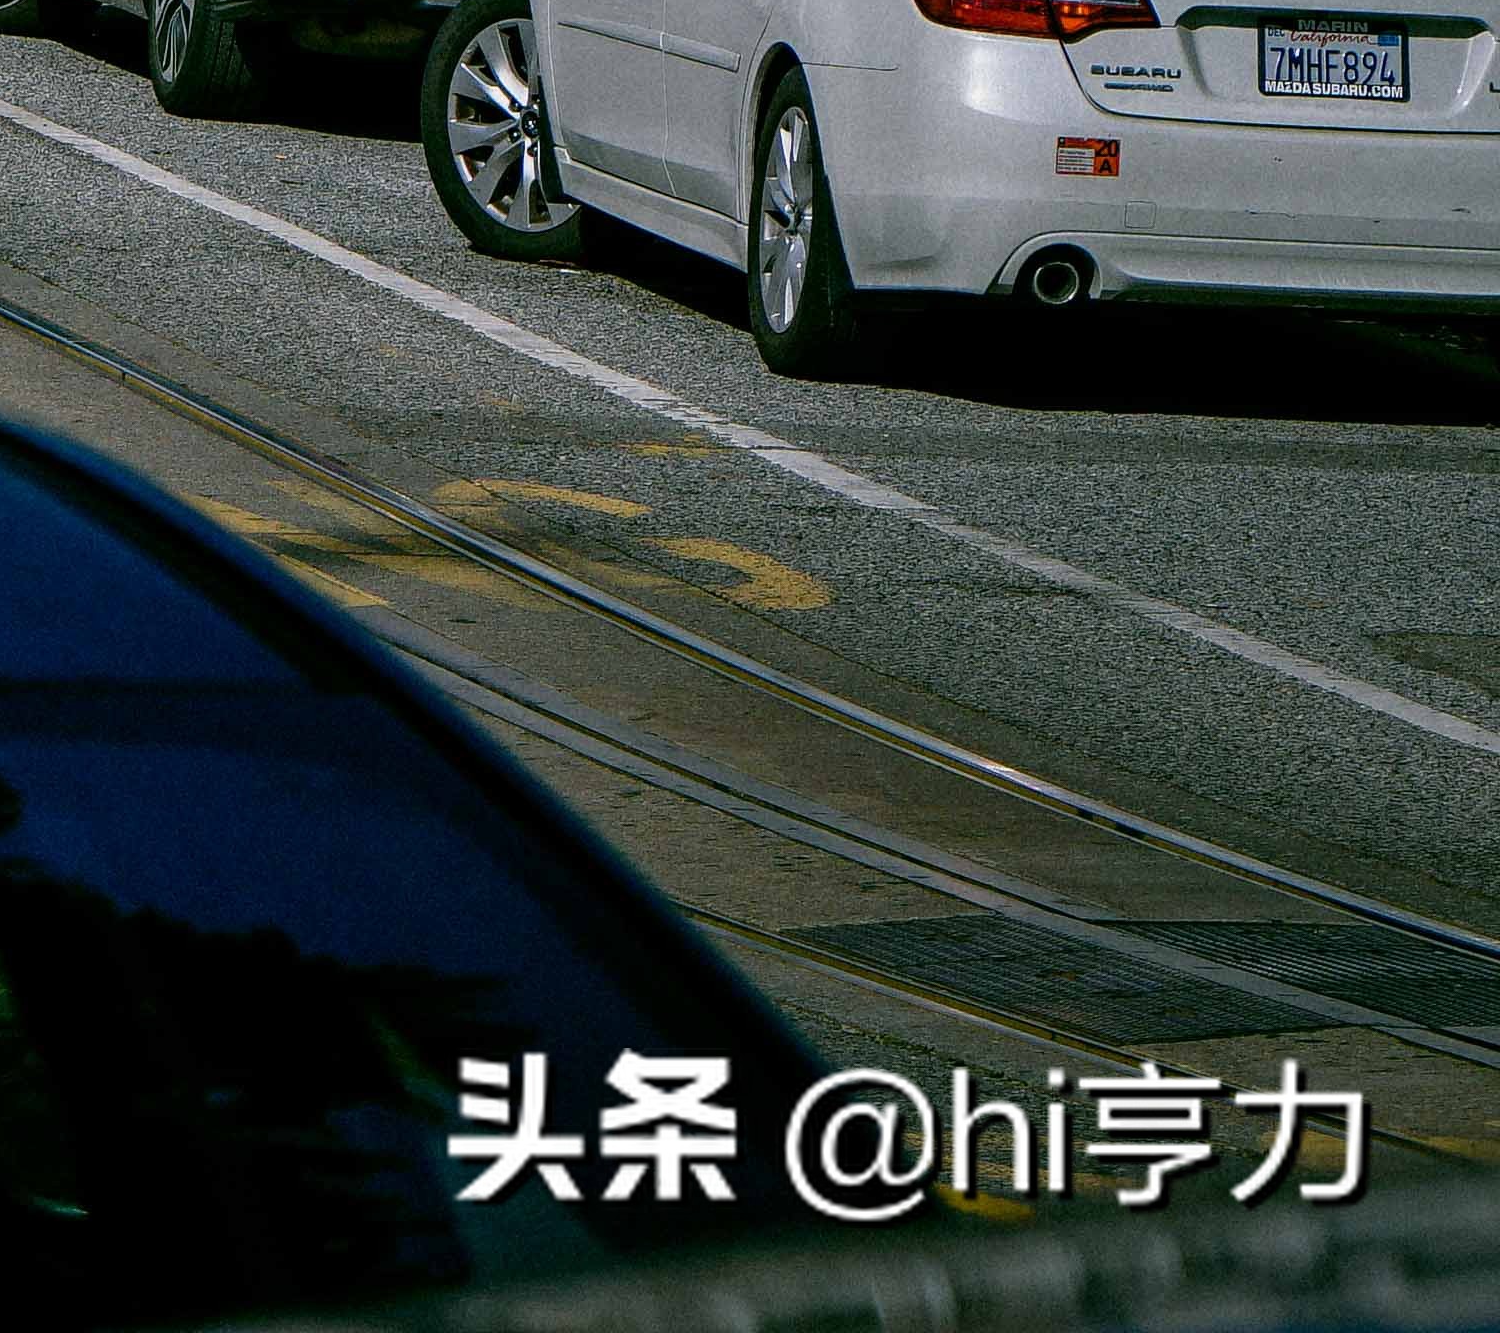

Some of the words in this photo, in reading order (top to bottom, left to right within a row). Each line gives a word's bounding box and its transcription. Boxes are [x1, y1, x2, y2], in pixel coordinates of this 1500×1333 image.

[1267, 27, 1285, 37] DEC
[1297, 18, 1369, 33] MARIN
[1290, 30, 1376, 47] California
[1090, 64, 1182, 79] SUBARU
[1270, 46, 1396, 86] 7MHF894
[1097, 139, 1119, 158] 20
[1099, 159, 1113, 174] A
